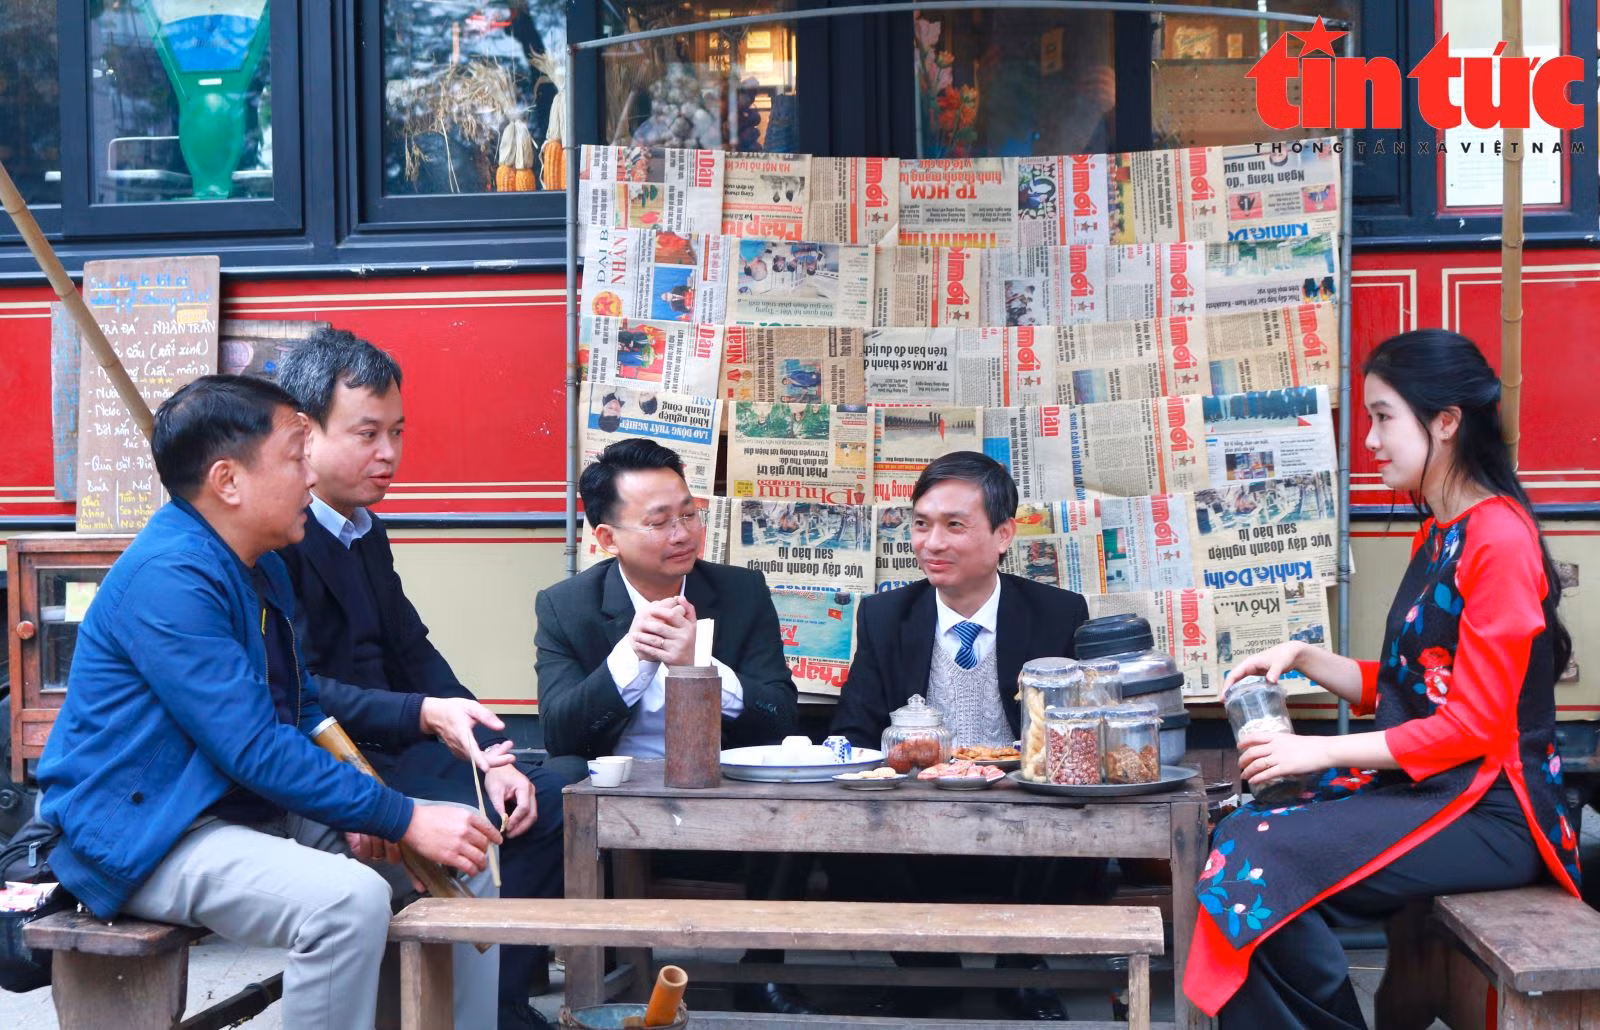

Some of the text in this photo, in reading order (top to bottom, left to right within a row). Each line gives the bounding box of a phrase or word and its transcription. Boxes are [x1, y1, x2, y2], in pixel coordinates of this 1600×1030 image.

[881, 346, 893, 357] du
[928, 346, 947, 357] trên
[913, 360, 948, 371] TP.HCM
[662, 401, 710, 417] thành công
[658, 411, 709, 428] khởi nghiệp
[1044, 406, 1061, 437] Dân
[649, 423, 670, 434] THẤT
[672, 426, 692, 438] ĐỘNG
[694, 429, 709, 439] LAO
[770, 463, 785, 477] giá
[787, 464, 805, 478] huy
[807, 466, 828, 478] Phát
[892, 480, 916, 501] hòng
[1253, 525, 1274, 539] bão
[1277, 522, 1298, 535] sau
[792, 547, 811, 561] bão
[815, 548, 833, 560] sau
[1208, 533, 1332, 561] Vực dậy doanh nghiệp
[786, 562, 819, 577] doanh
[822, 562, 841, 577] dậy
[844, 562, 864, 579] Vực
[893, 558, 920, 570] oanh
[1251, 597, 1281, 618] Khổ
